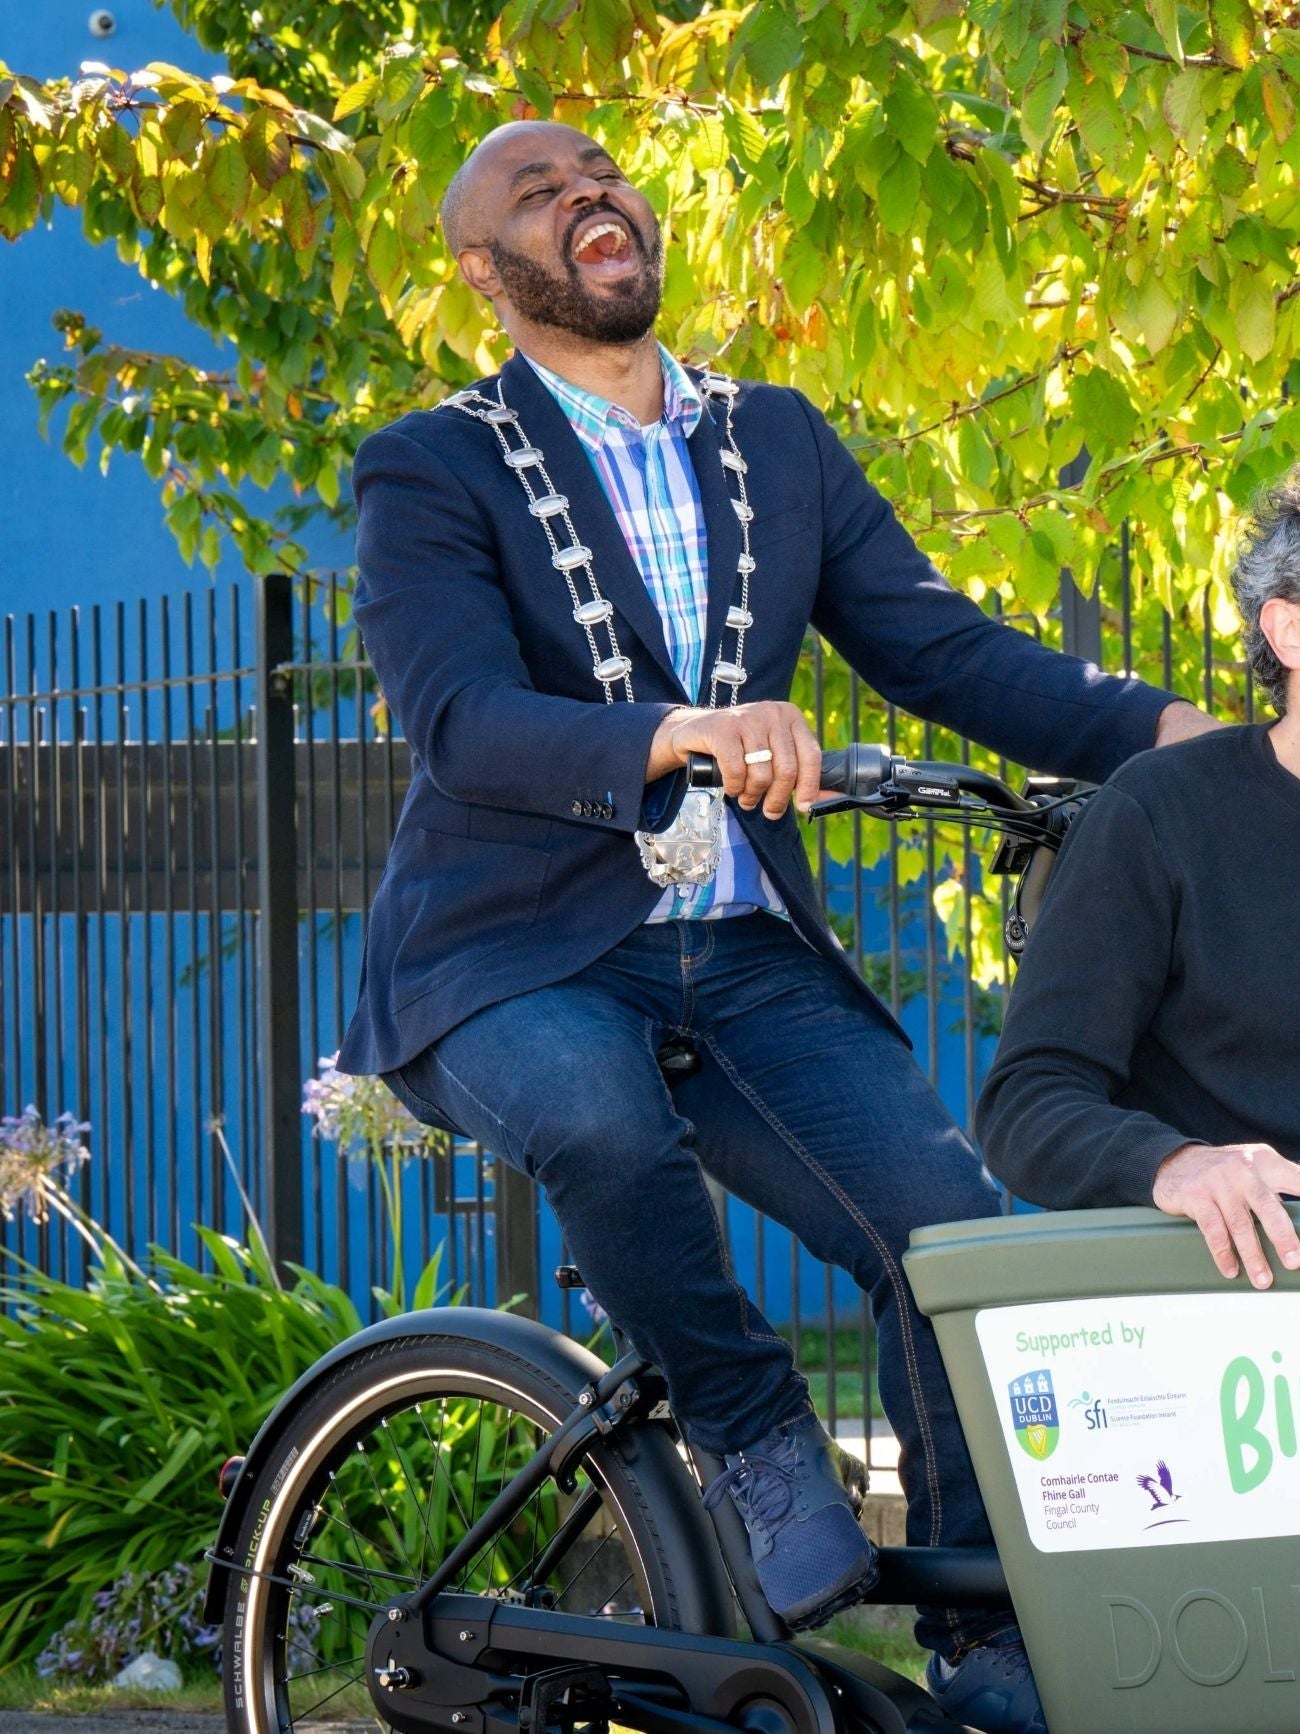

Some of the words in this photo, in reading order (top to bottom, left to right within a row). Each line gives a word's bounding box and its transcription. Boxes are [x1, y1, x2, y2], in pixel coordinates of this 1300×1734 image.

[1016, 1322, 1114, 1357] Supported
[1120, 1321, 1145, 1349] by
[1014, 1396, 1052, 1414] UCD
[1019, 1413, 1052, 1423] DUBLIN
[1040, 1474, 1086, 1487] Comhairle
[1087, 1473, 1119, 1484] Contae
[1042, 1490, 1067, 1501] Fhine
[1068, 1488, 1086, 1499] Gall
[1044, 1504, 1069, 1517] Fingal
[1070, 1503, 1100, 1515] County
[1046, 1517, 1077, 1530] Council
[233, 1602, 246, 1709] SCHWALBE
